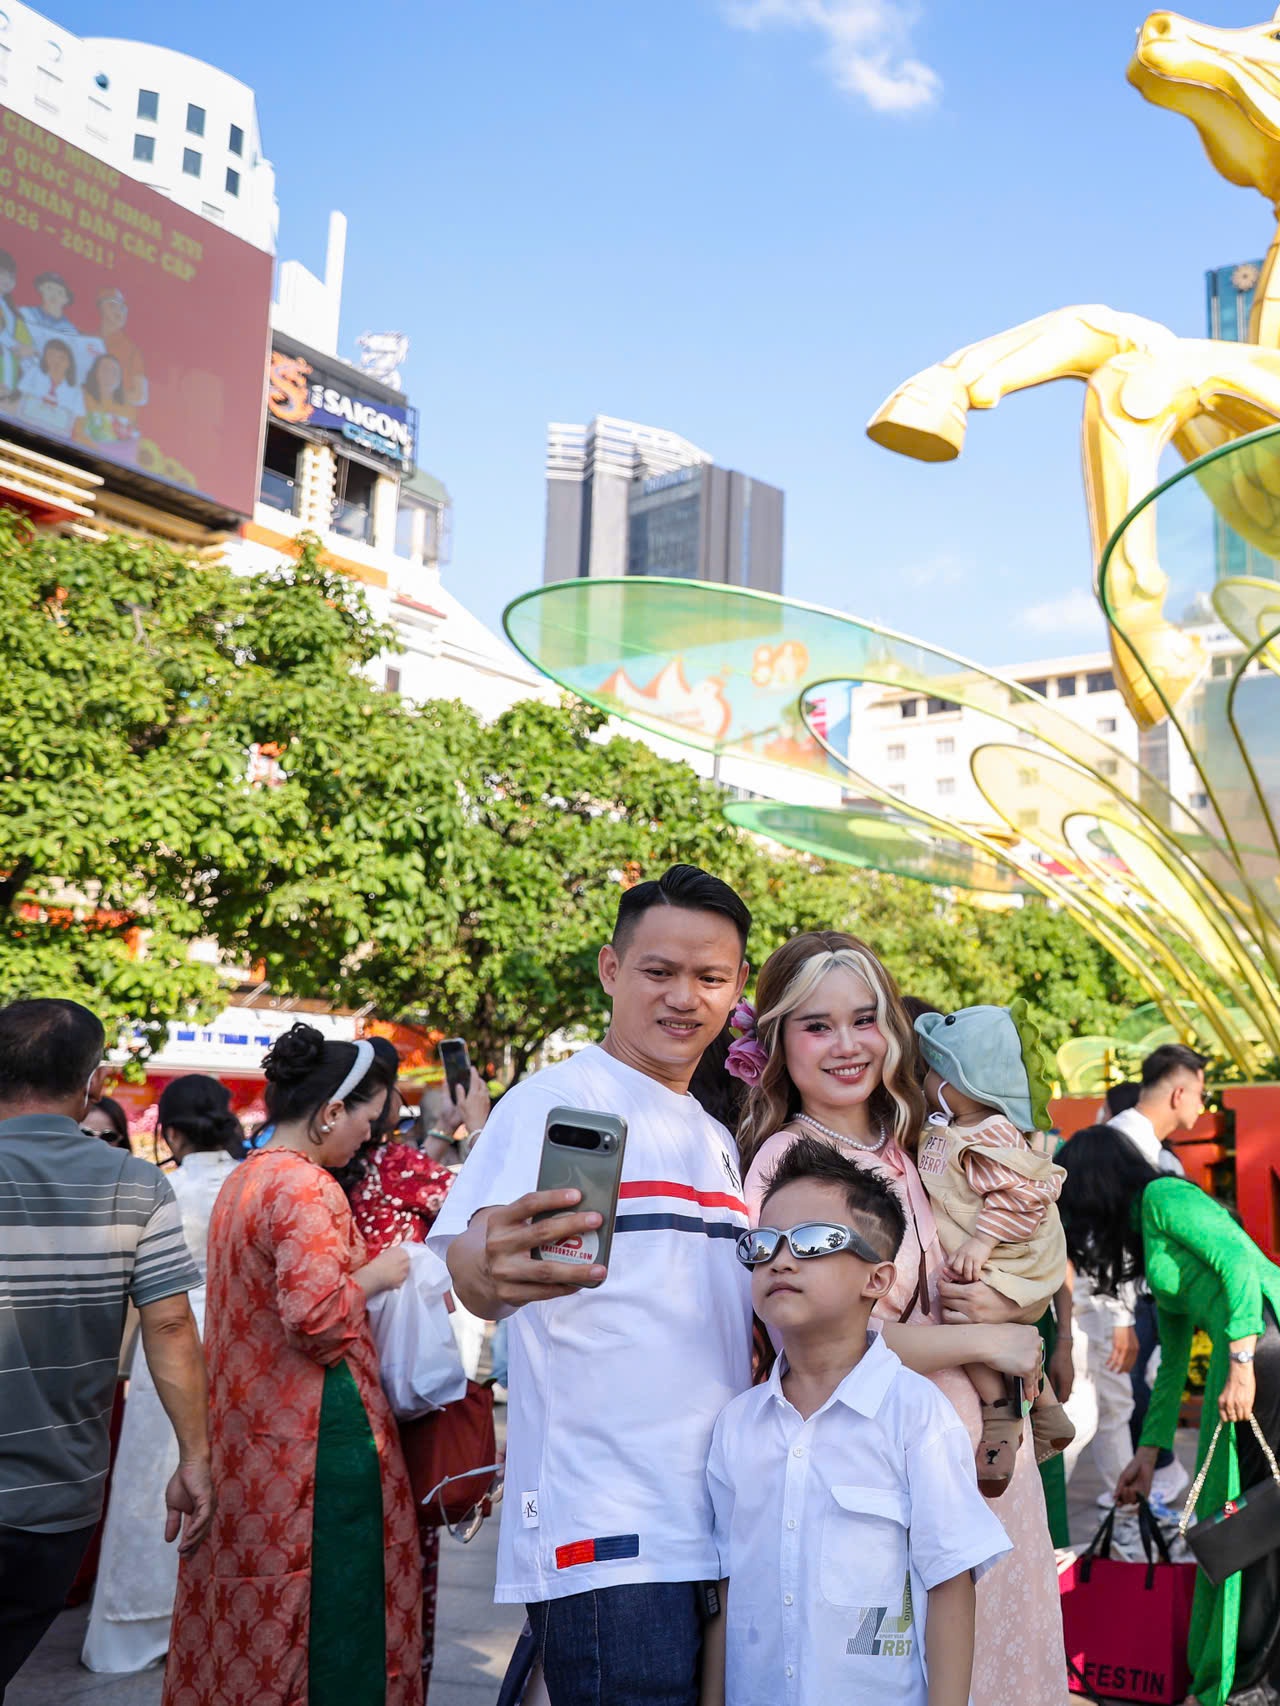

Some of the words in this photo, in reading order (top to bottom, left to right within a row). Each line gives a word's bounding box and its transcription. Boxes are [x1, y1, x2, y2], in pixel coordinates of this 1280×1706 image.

[323, 388, 412, 446] SAIGON
[919, 1154, 947, 1175] BERRY
[882, 1640, 912, 1656] RBT
[1084, 1662, 1165, 1695] FESTIN
